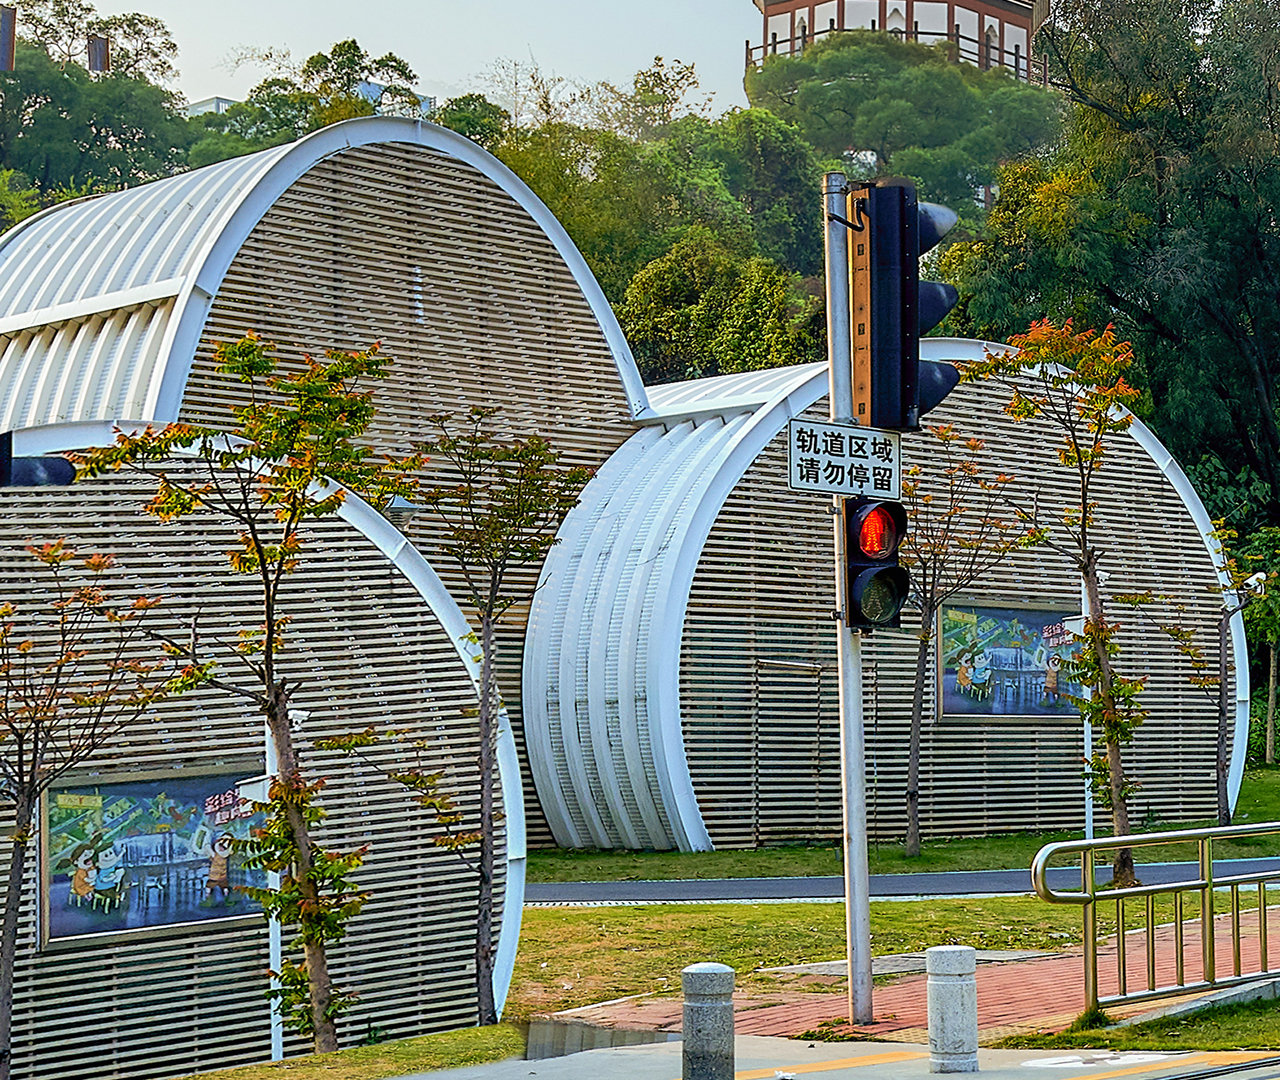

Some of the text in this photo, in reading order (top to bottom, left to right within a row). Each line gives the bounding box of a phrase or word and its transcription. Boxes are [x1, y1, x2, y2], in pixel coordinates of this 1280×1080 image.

[796, 427, 893, 463] 轨道区域
[796, 457, 893, 491] 请勿停留
